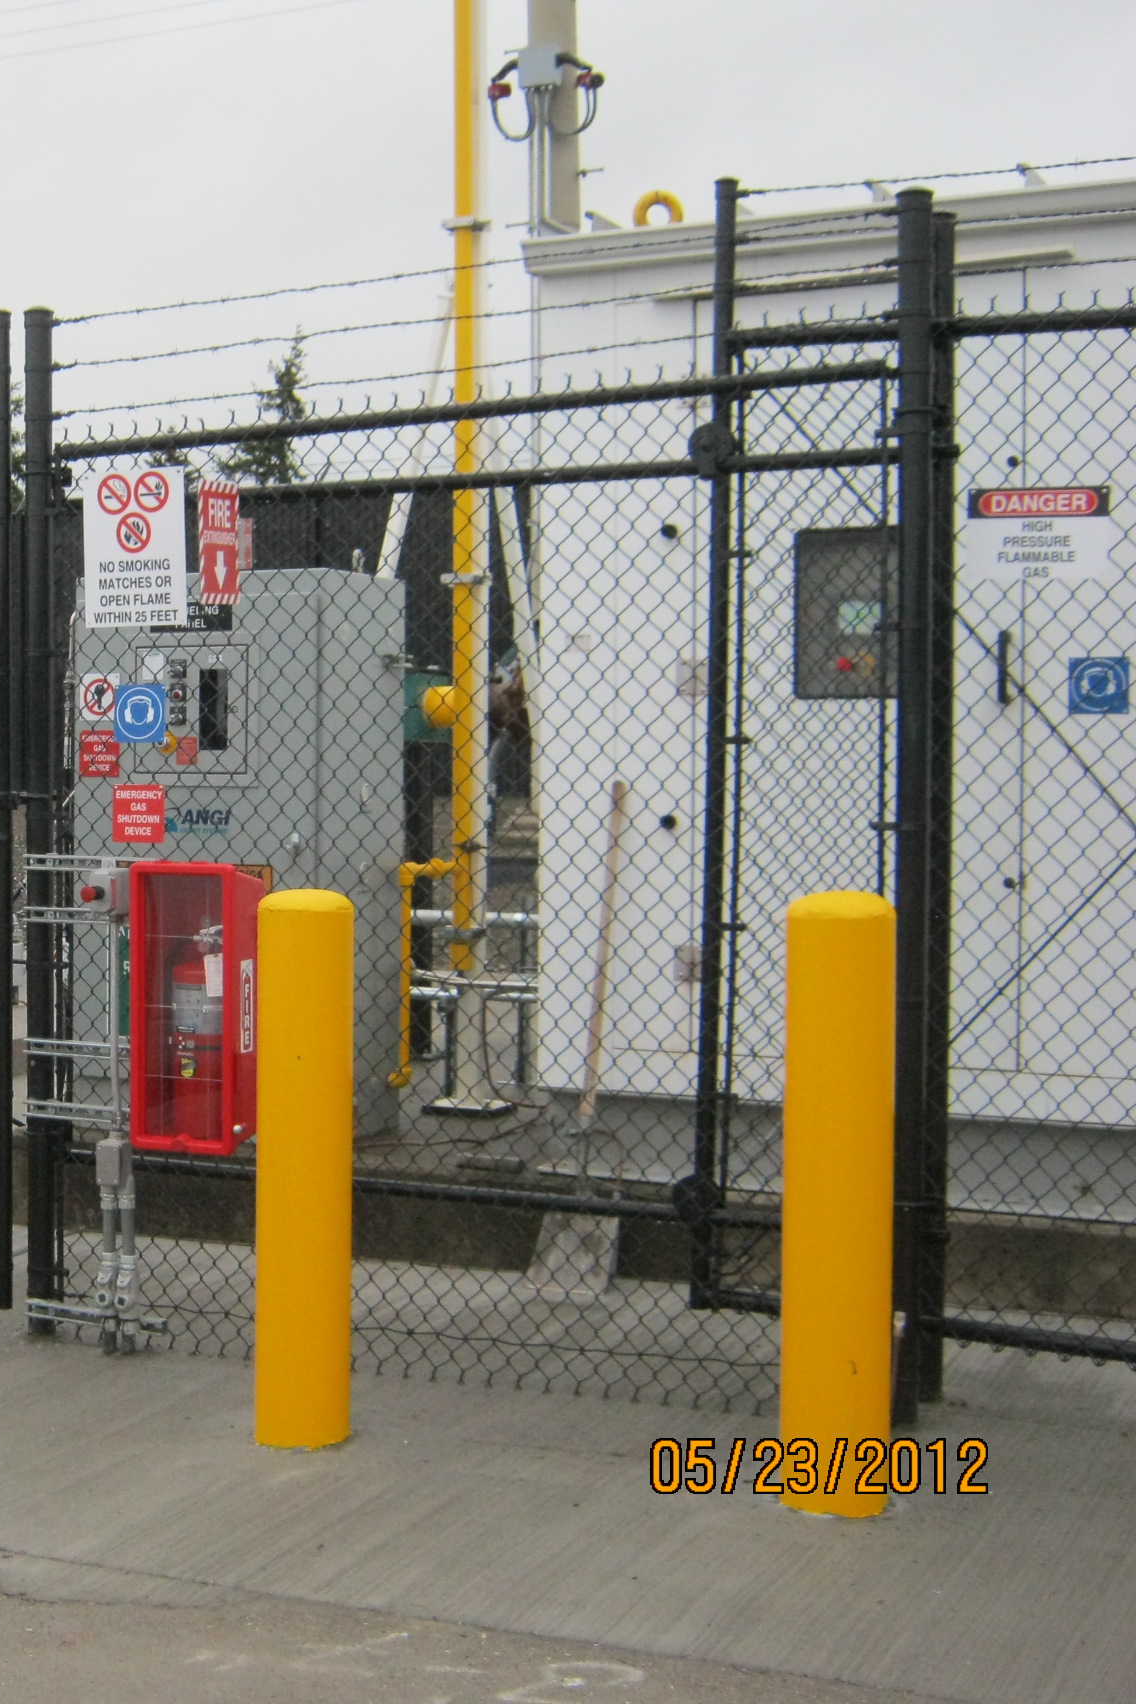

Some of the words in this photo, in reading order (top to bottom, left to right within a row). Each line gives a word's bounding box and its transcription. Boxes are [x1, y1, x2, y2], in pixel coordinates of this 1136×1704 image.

[991, 493, 1088, 513] DANGER
[208, 497, 231, 528] FIRE
[1022, 521, 1053, 532] HIGH
[1003, 536, 1071, 548] PRESSURE
[997, 551, 1076, 563] FLAMMABLE
[99, 561, 115, 573] NO
[118, 558, 171, 572] SMOKING
[1022, 566, 1050, 578] GAS
[99, 577, 152, 590] MATCHES
[155, 576, 172, 588] OR
[100, 595, 131, 606] OPEN
[134, 593, 171, 605] FLAME
[94, 611, 133, 624] WITHIN
[135, 611, 147, 623] 25
[150, 609, 179, 622] FEET
[175, 619, 207, 629] NEL
[115, 790, 163, 800] EMERGENCY
[130, 802, 147, 812] GAS
[117, 814, 160, 824] SHUTDOWN
[181, 809, 231, 826] ANGI
[124, 827, 152, 836] DEVICE
